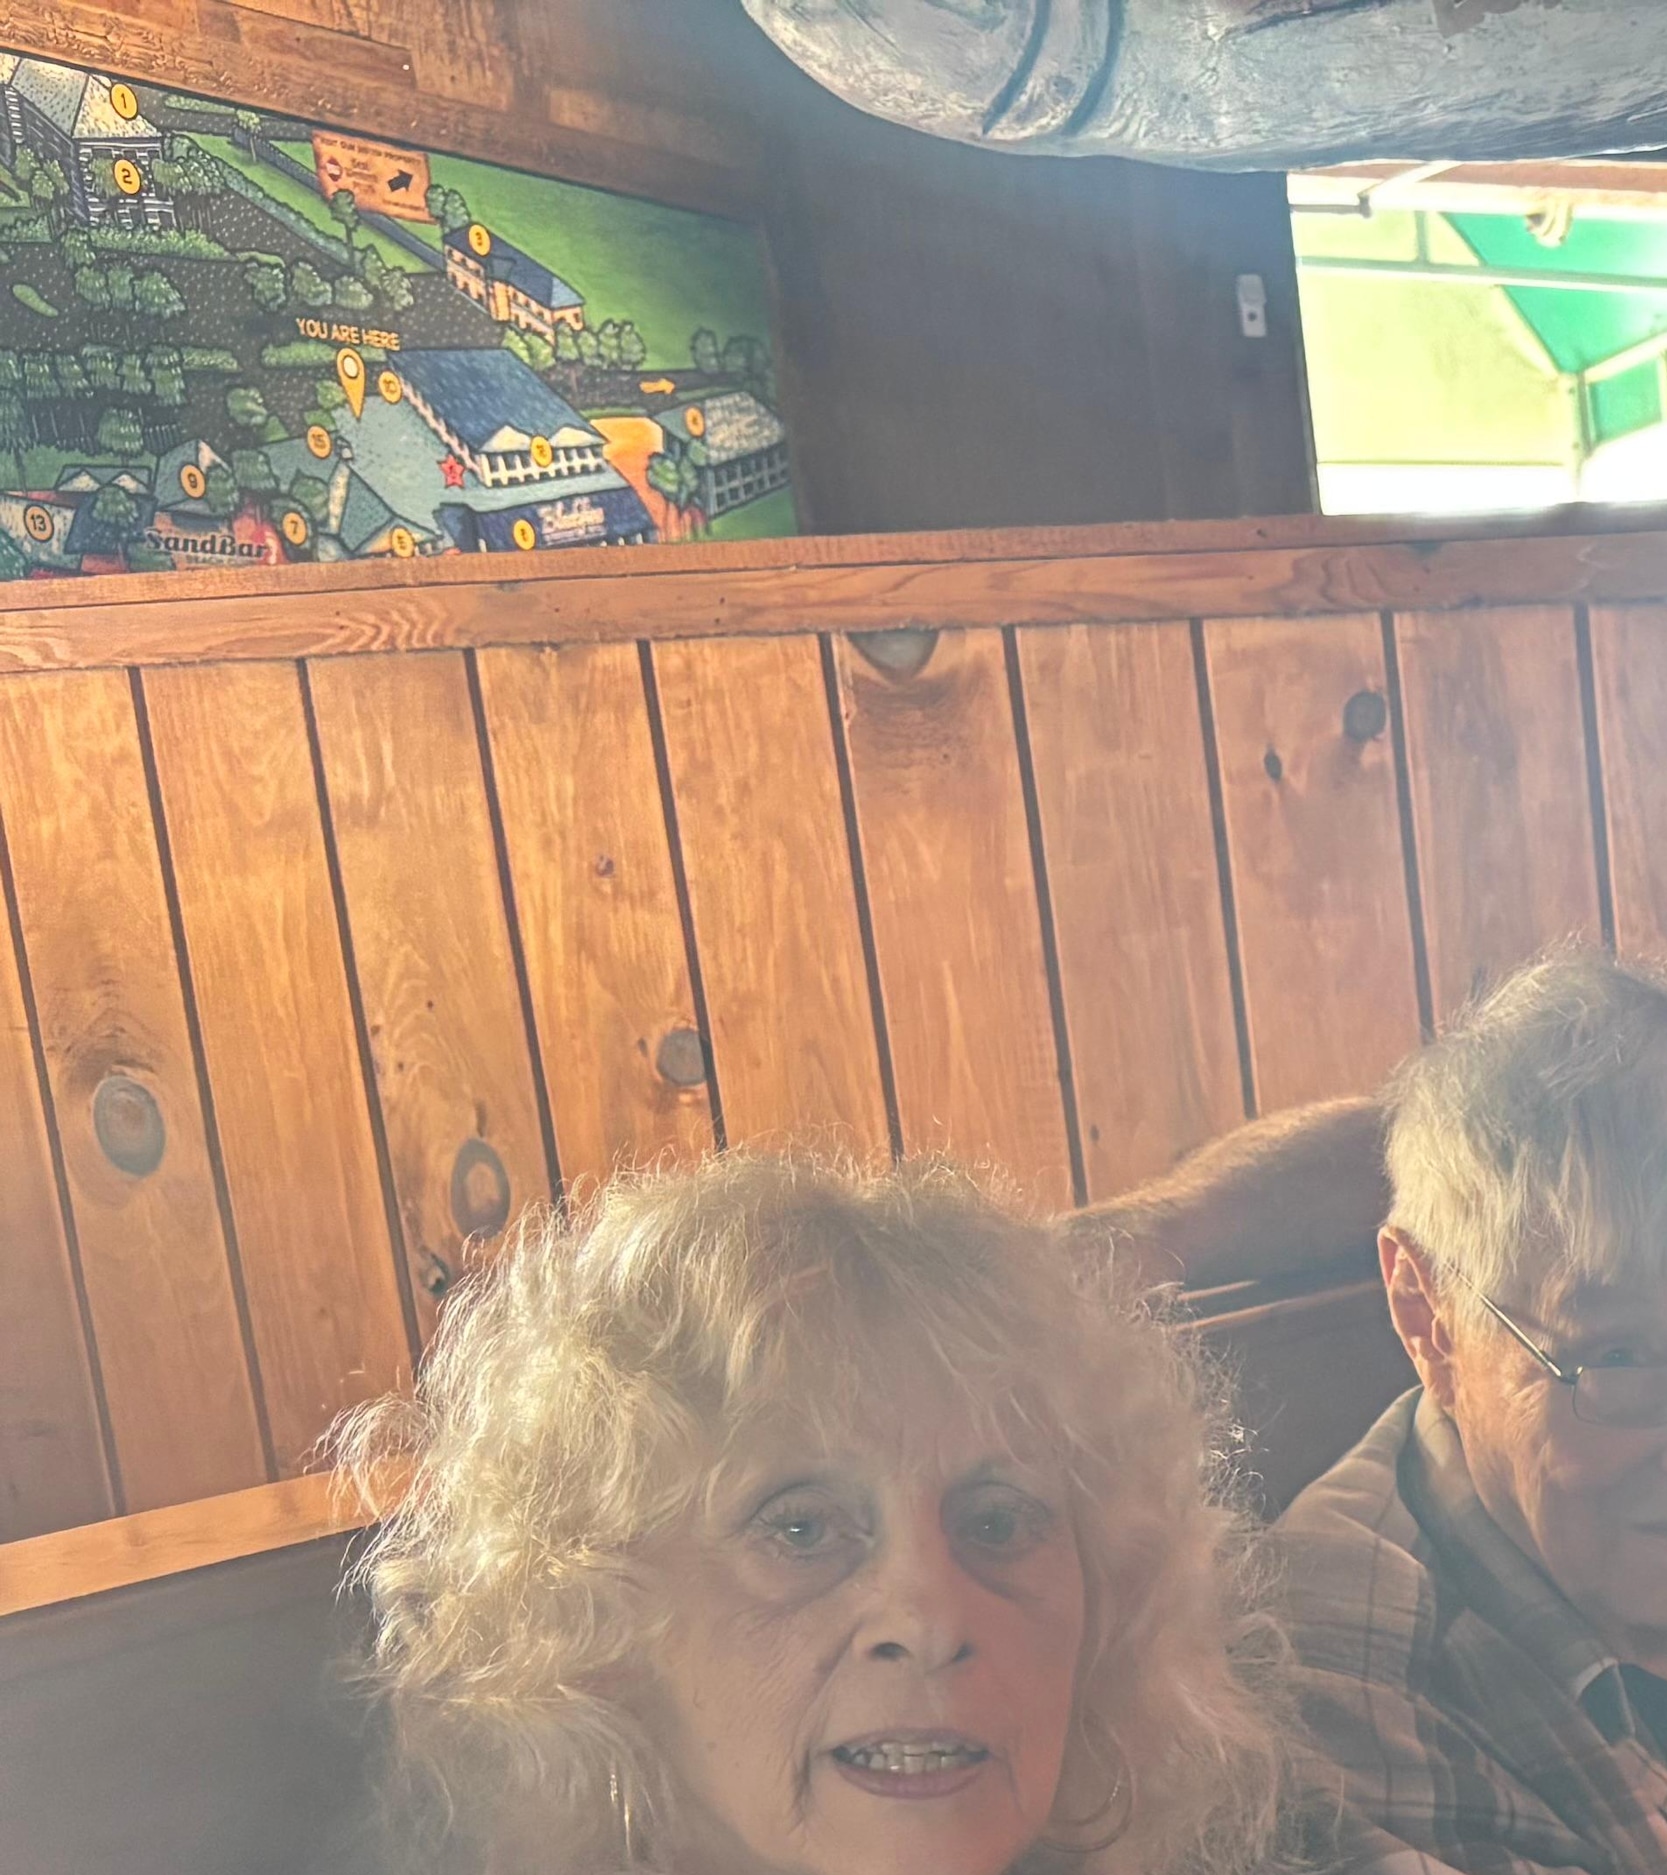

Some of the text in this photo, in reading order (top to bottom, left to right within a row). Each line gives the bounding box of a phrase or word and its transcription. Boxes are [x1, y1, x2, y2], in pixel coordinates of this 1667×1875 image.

[122, 167, 132, 184] 2
[295, 317, 400, 351] YOU ARE HERE
[187, 473, 198, 488] 9
[29, 514, 47, 532] 13
[289, 520, 298, 535] 7
[143, 527, 269, 558] SandBar
